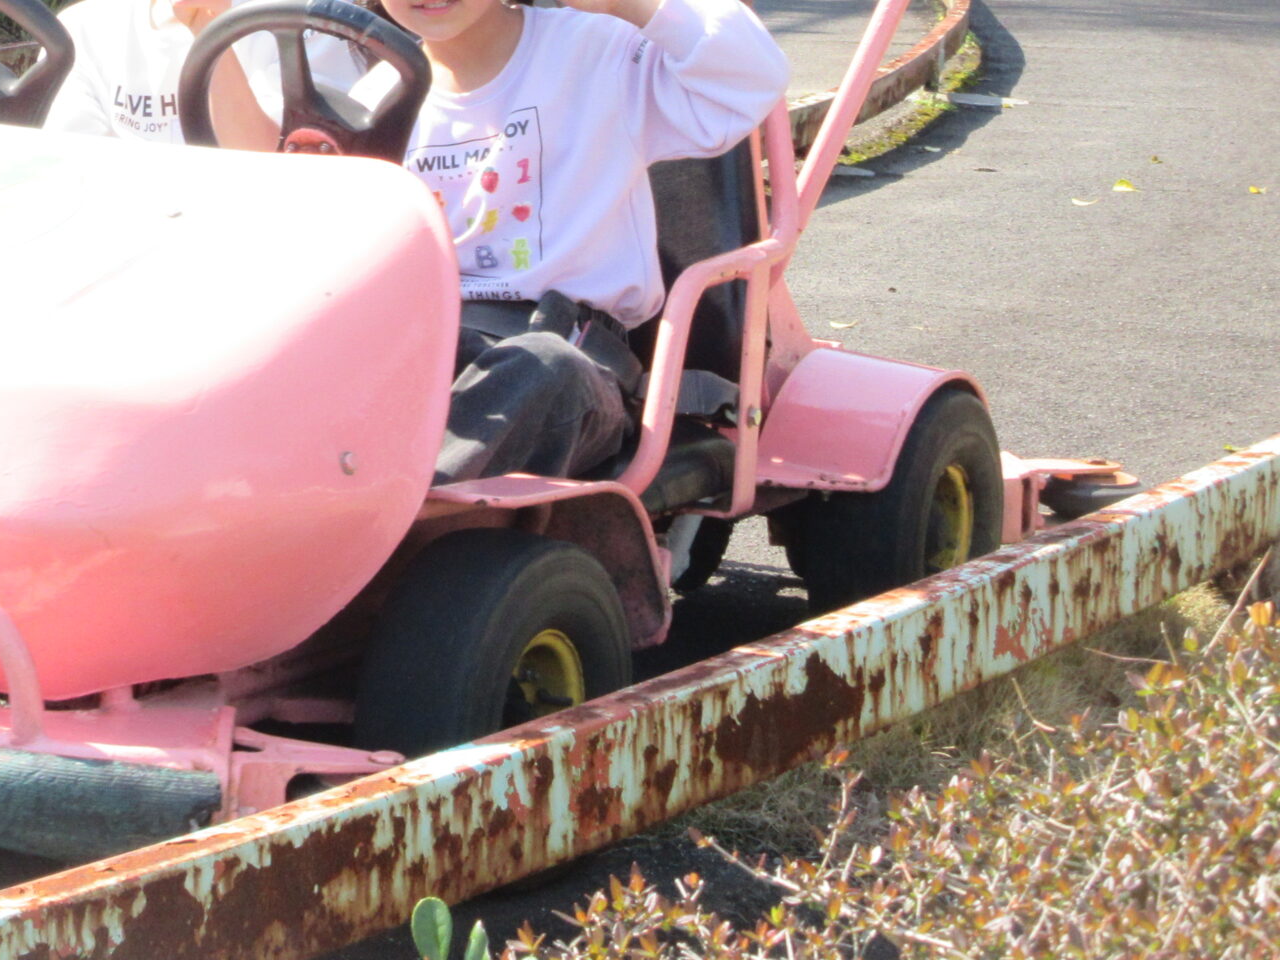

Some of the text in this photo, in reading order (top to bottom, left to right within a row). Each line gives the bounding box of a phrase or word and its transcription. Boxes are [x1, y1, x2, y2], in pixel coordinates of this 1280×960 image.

[632, 38, 649, 64] BETTE
[160, 93, 177, 116] H
[416, 154, 460, 173] WILL
[464, 146, 491, 165] MA
[504, 119, 529, 138] OY
[475, 245, 498, 269] B
[469, 290, 522, 300] THINGS
